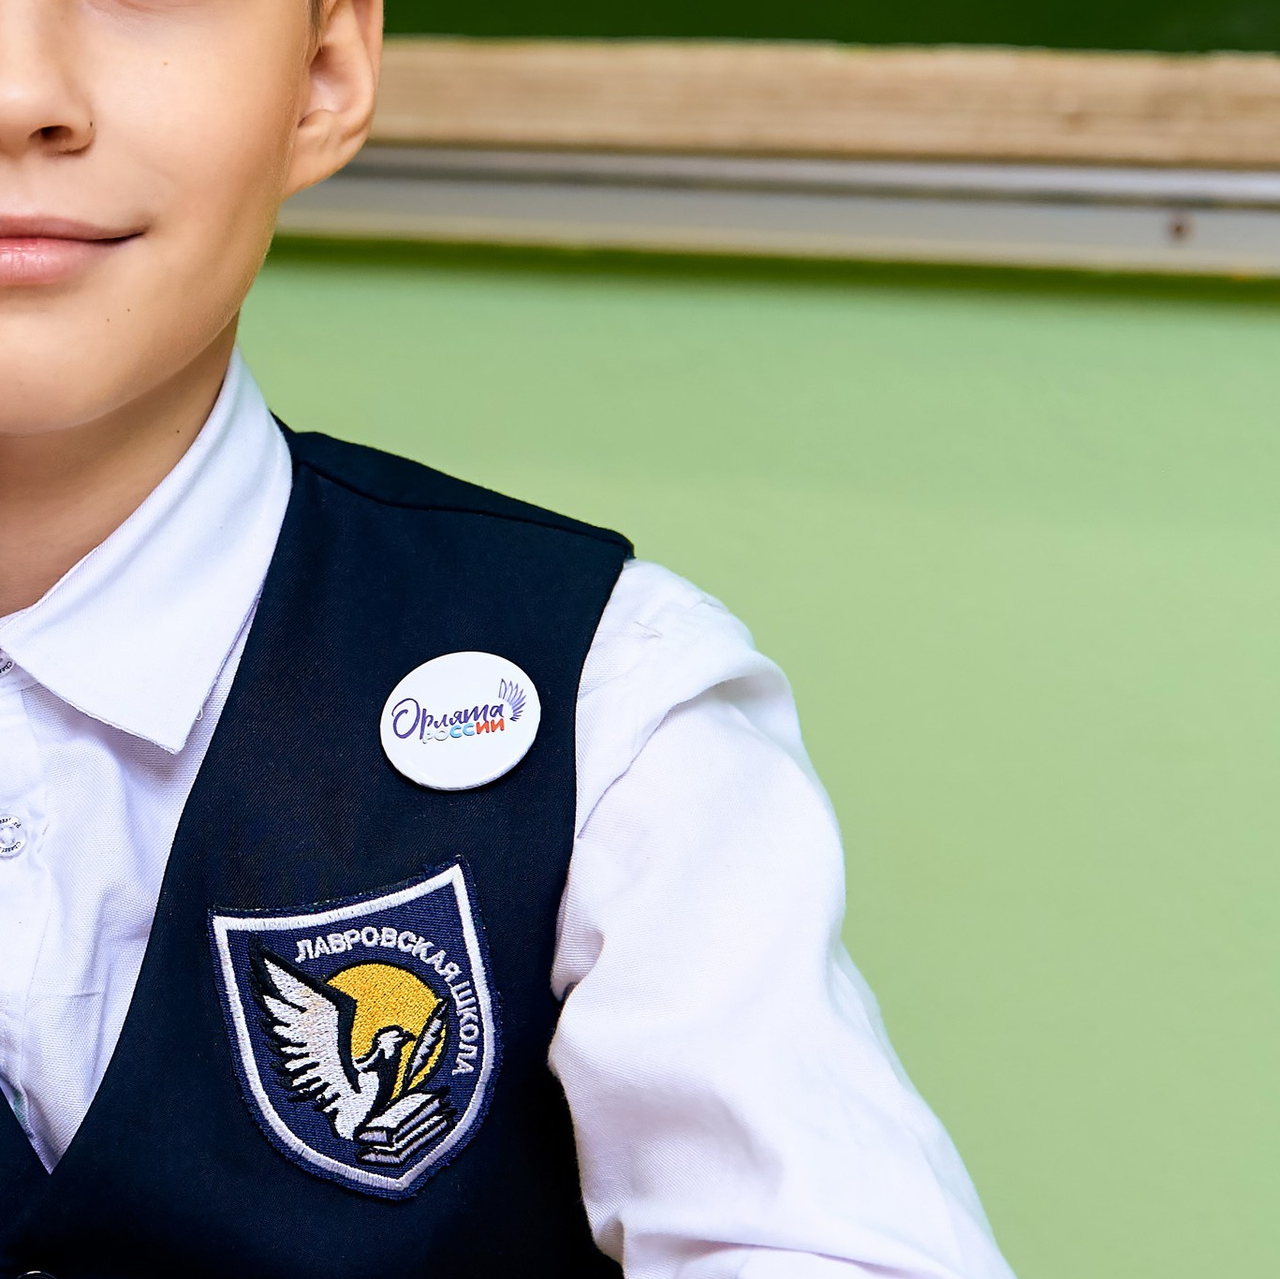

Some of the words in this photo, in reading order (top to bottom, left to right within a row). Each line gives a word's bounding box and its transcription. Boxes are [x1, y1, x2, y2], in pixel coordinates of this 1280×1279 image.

[391, 697, 505, 740] Орлята
[294, 926, 462, 985] ЛАВРОВСКАЯ
[451, 983, 479, 1076] ШКОЛА
